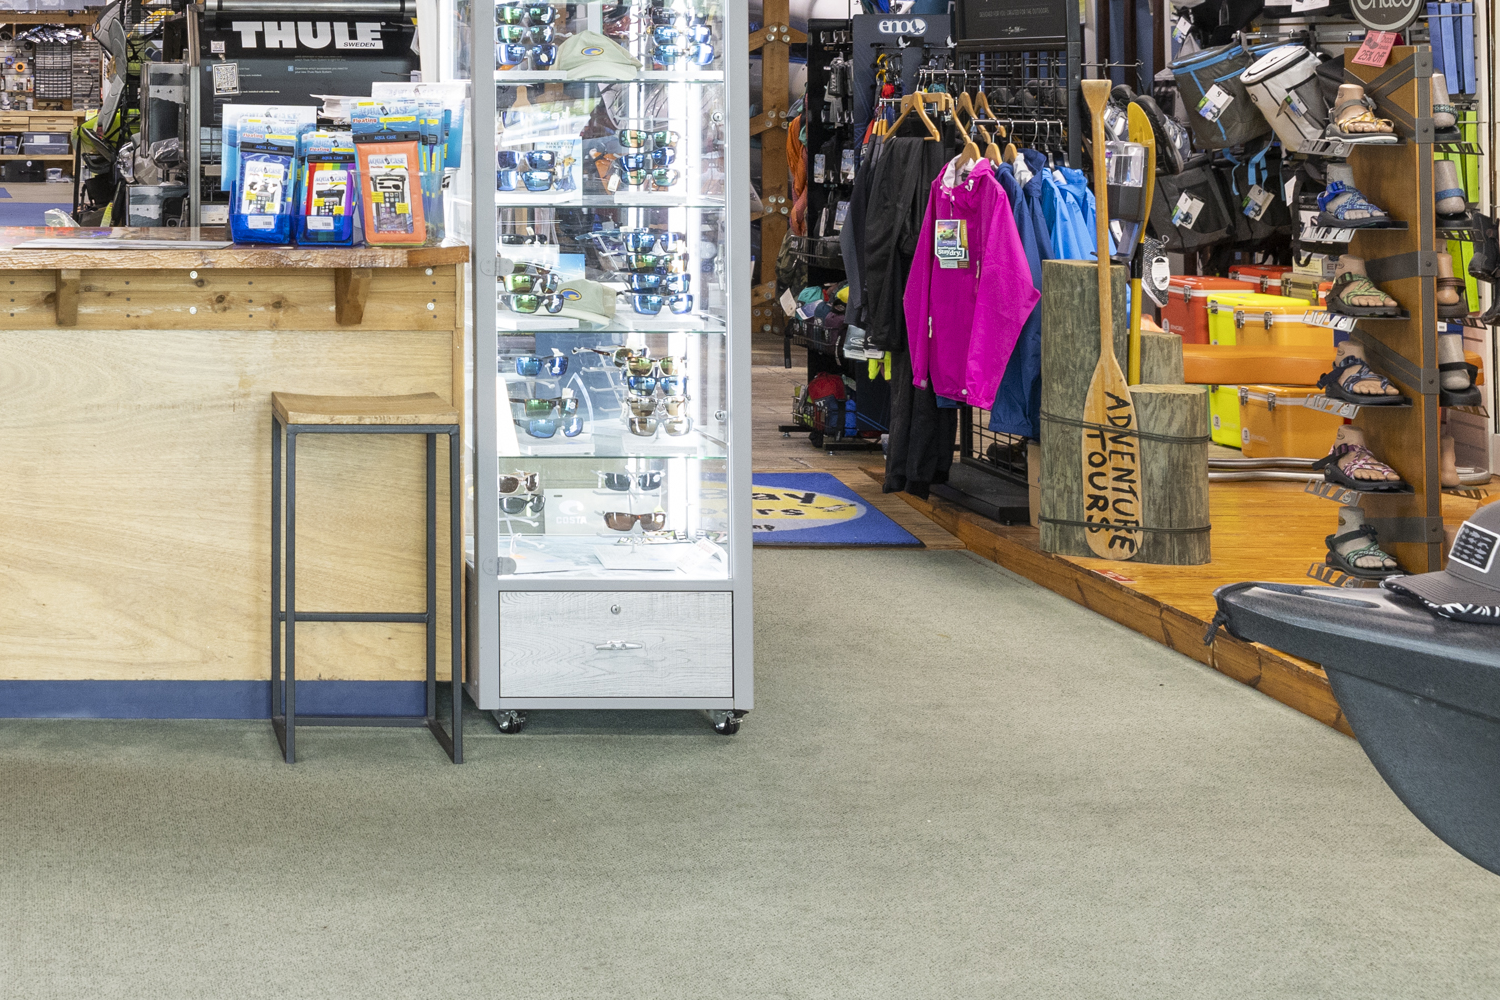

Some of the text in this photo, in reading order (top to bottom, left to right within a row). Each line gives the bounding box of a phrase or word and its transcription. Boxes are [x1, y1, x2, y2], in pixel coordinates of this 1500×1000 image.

[232, 22, 384, 50] THULE
[1358, 50, 1373, 62] 25%
[1086, 391, 1140, 554] ADVENTURE TOURS
[556, 516, 587, 524] COSTA
